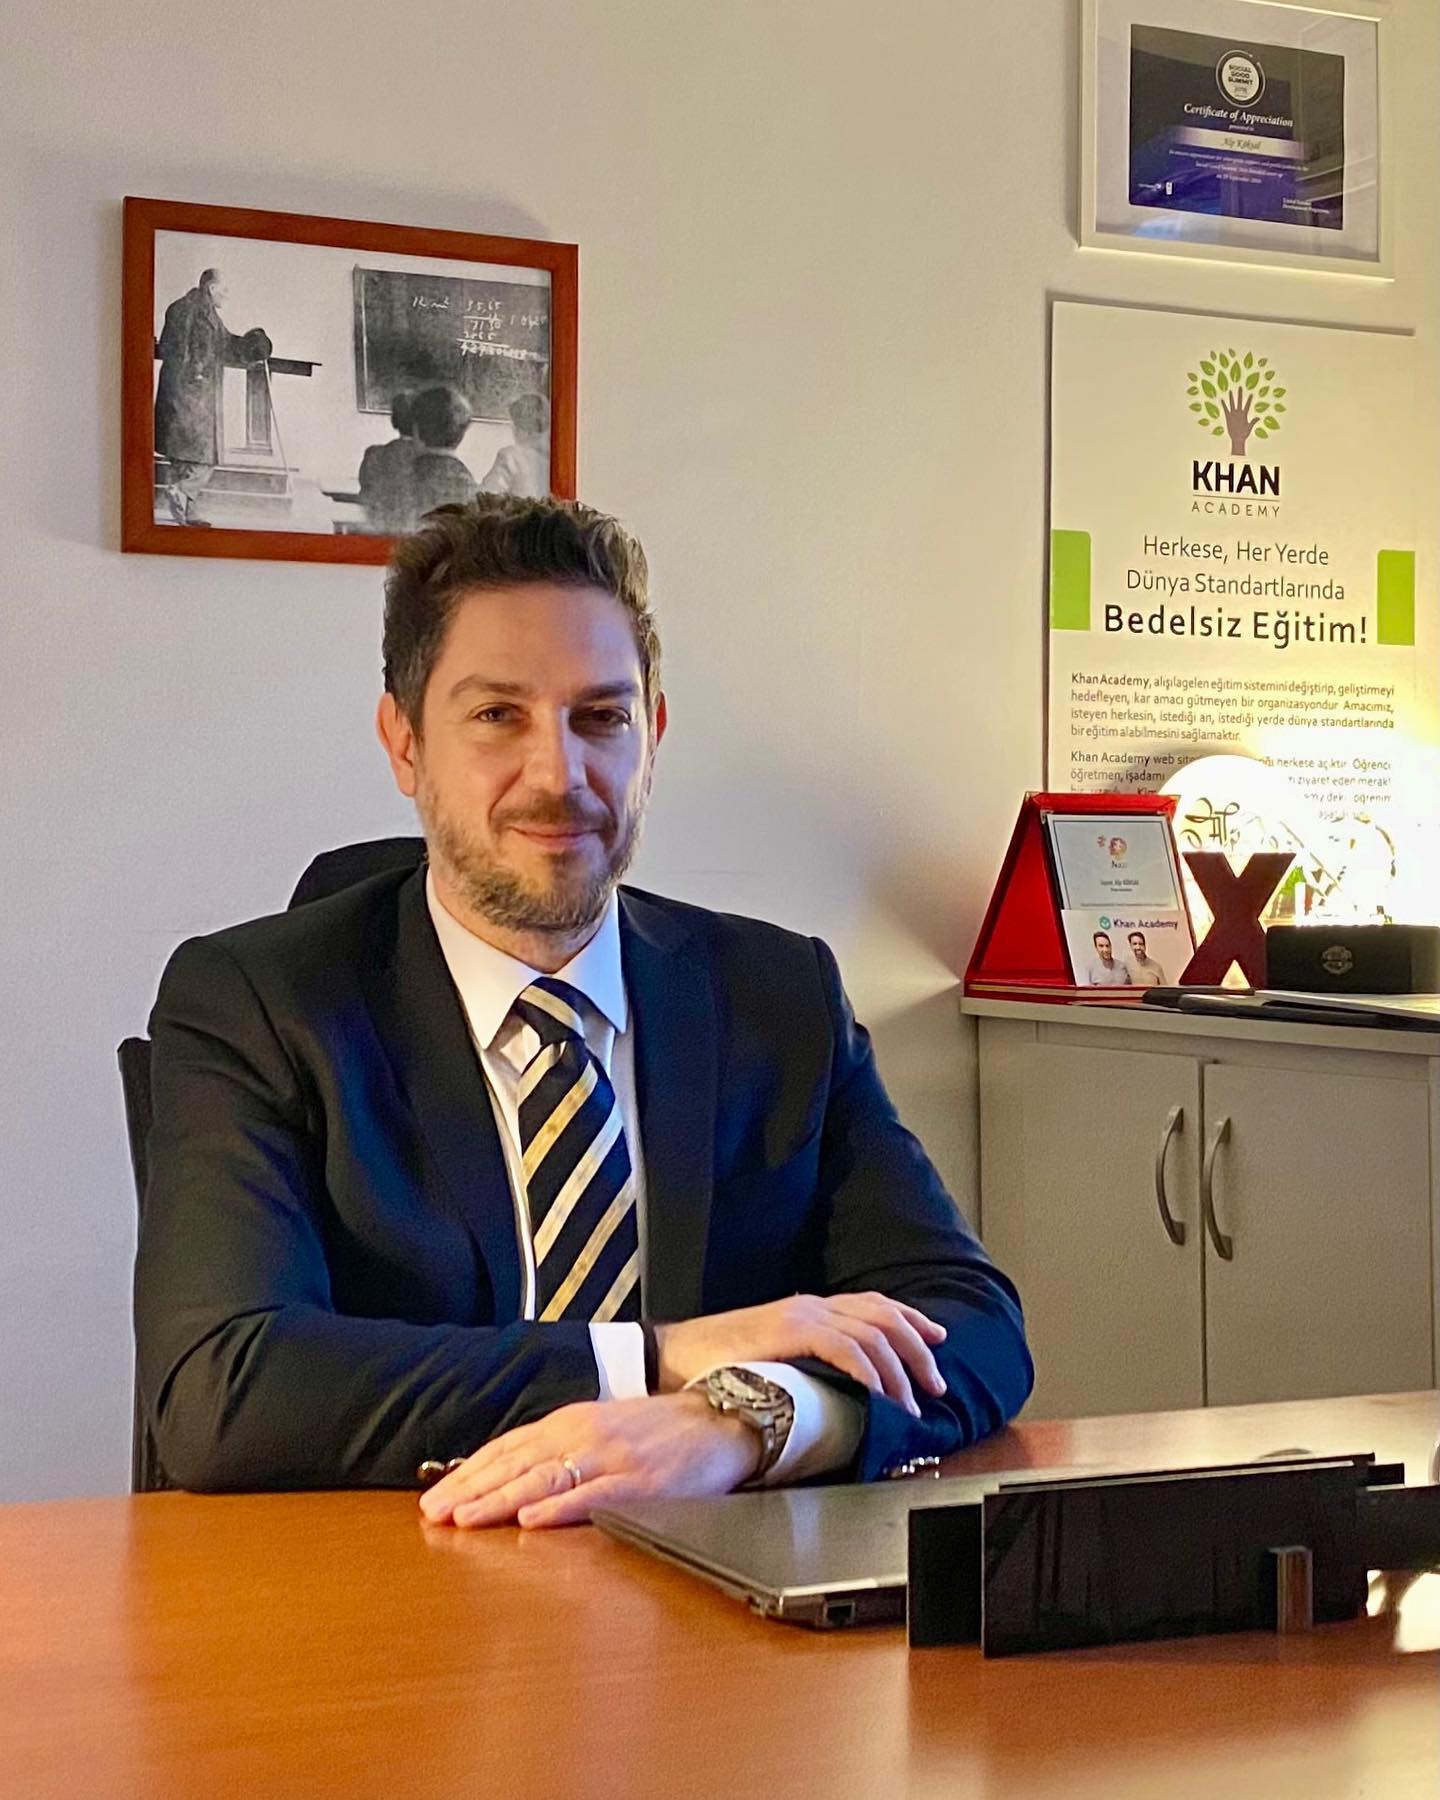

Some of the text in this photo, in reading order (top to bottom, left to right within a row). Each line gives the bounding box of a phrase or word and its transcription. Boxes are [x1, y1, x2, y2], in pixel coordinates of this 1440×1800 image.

[1184, 102, 1293, 127] Certificate of Appreciation
[1192, 460, 1280, 496] KHAN
[1191, 501, 1280, 518] ACADEMY
[1144, 535, 1329, 566] Herkese, Her Yerde
[1127, 569, 1345, 601] Dünya Standartlarında
[1105, 604, 1367, 650] Bedelsiz Eğitim!
[1071, 672, 1395, 698] Khan Academy, alışılagelen eğitim sistemini değiştirip, geliştirmeyi
[1071, 690, 1130, 705] hedefleyen,
[1134, 692, 1150, 704] kar
[1153, 695, 1184, 705] amacı
[1187, 695, 1238, 709] gütmeyen
[1241, 696, 1254, 707] bir
[1343, 700, 1395, 714] Amacımız,
[1071, 708, 1394, 729] isteyen herkesin, istediği an, istediği yerde dünya standartlarında
[1071, 725, 1086, 736] bir
[1086, 725, 1118, 739] eğitim
[1120, 727, 1180, 739] alabilmesini
[1071, 751, 1098, 763] Khan
[1101, 752, 1150, 767] Academy
[1153, 754, 1174, 765] web
[1071, 769, 1124, 783] öğretmen,
[1126, 769, 1166, 783] işadamı
[1113, 918, 1178, 931] Khan Academy
